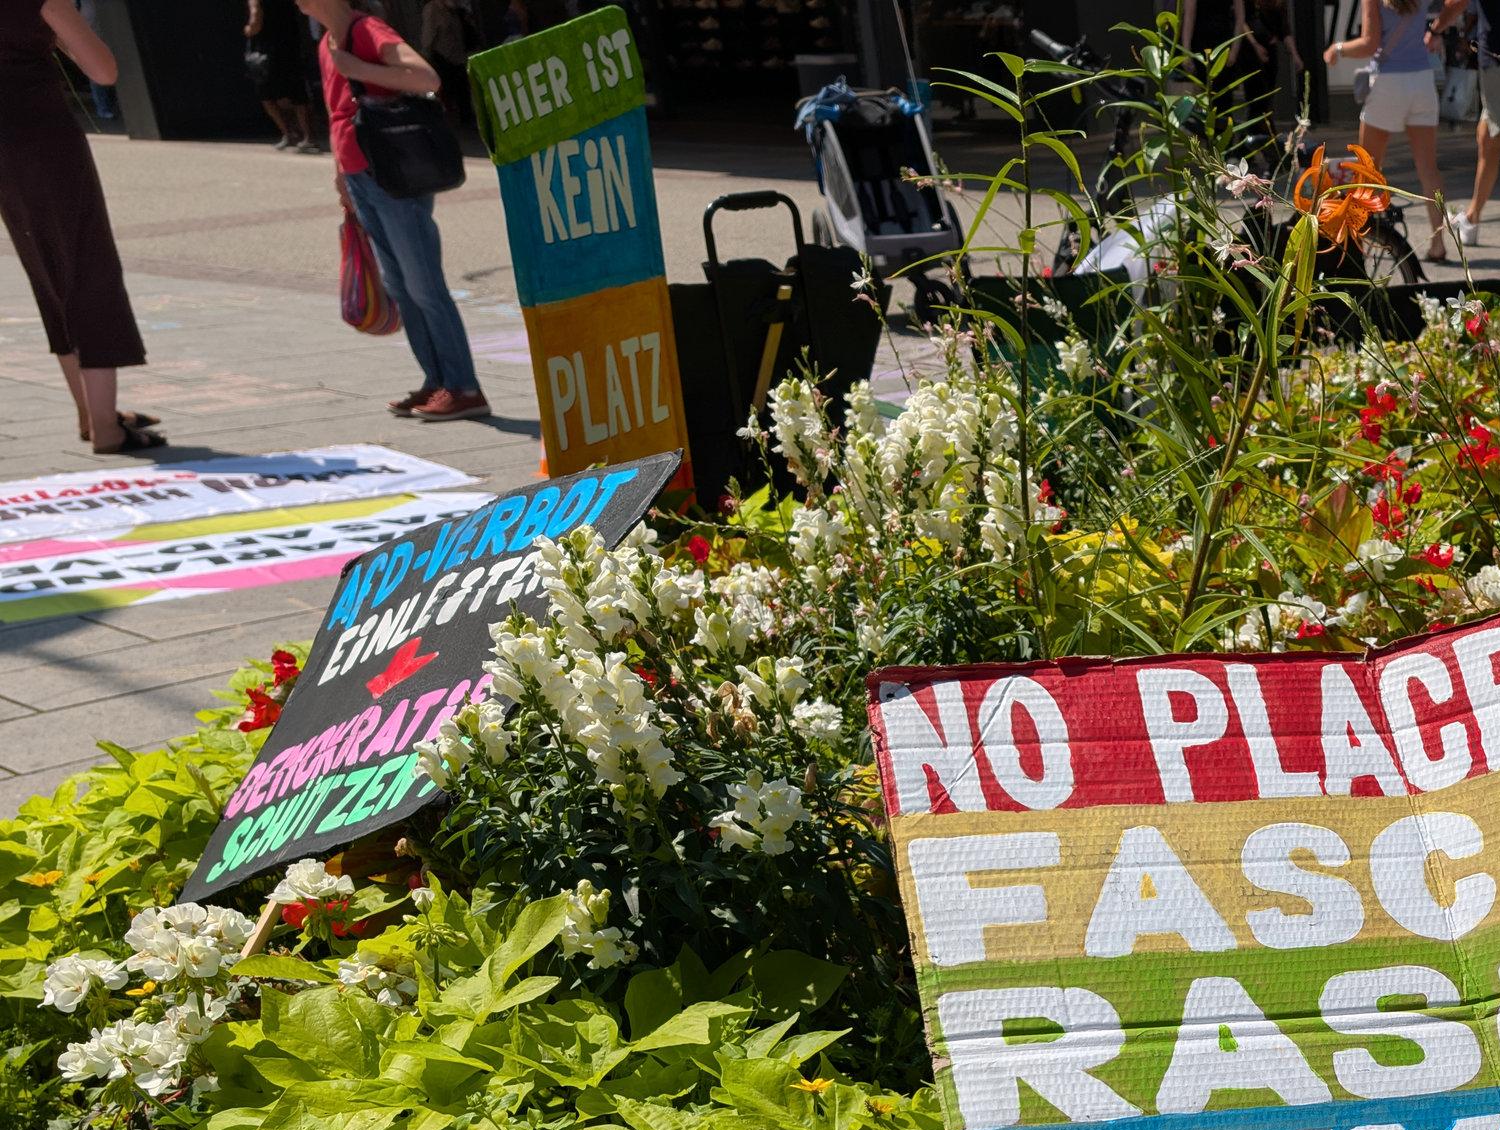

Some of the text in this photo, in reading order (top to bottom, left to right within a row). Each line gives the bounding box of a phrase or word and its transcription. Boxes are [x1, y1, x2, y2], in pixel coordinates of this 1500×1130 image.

[547, 332, 669, 450] PLATZ
[0, 529, 411, 592] AARLAND
[327, 468, 639, 630] AFD-VERBOT
[878, 680, 1074, 816] NO
